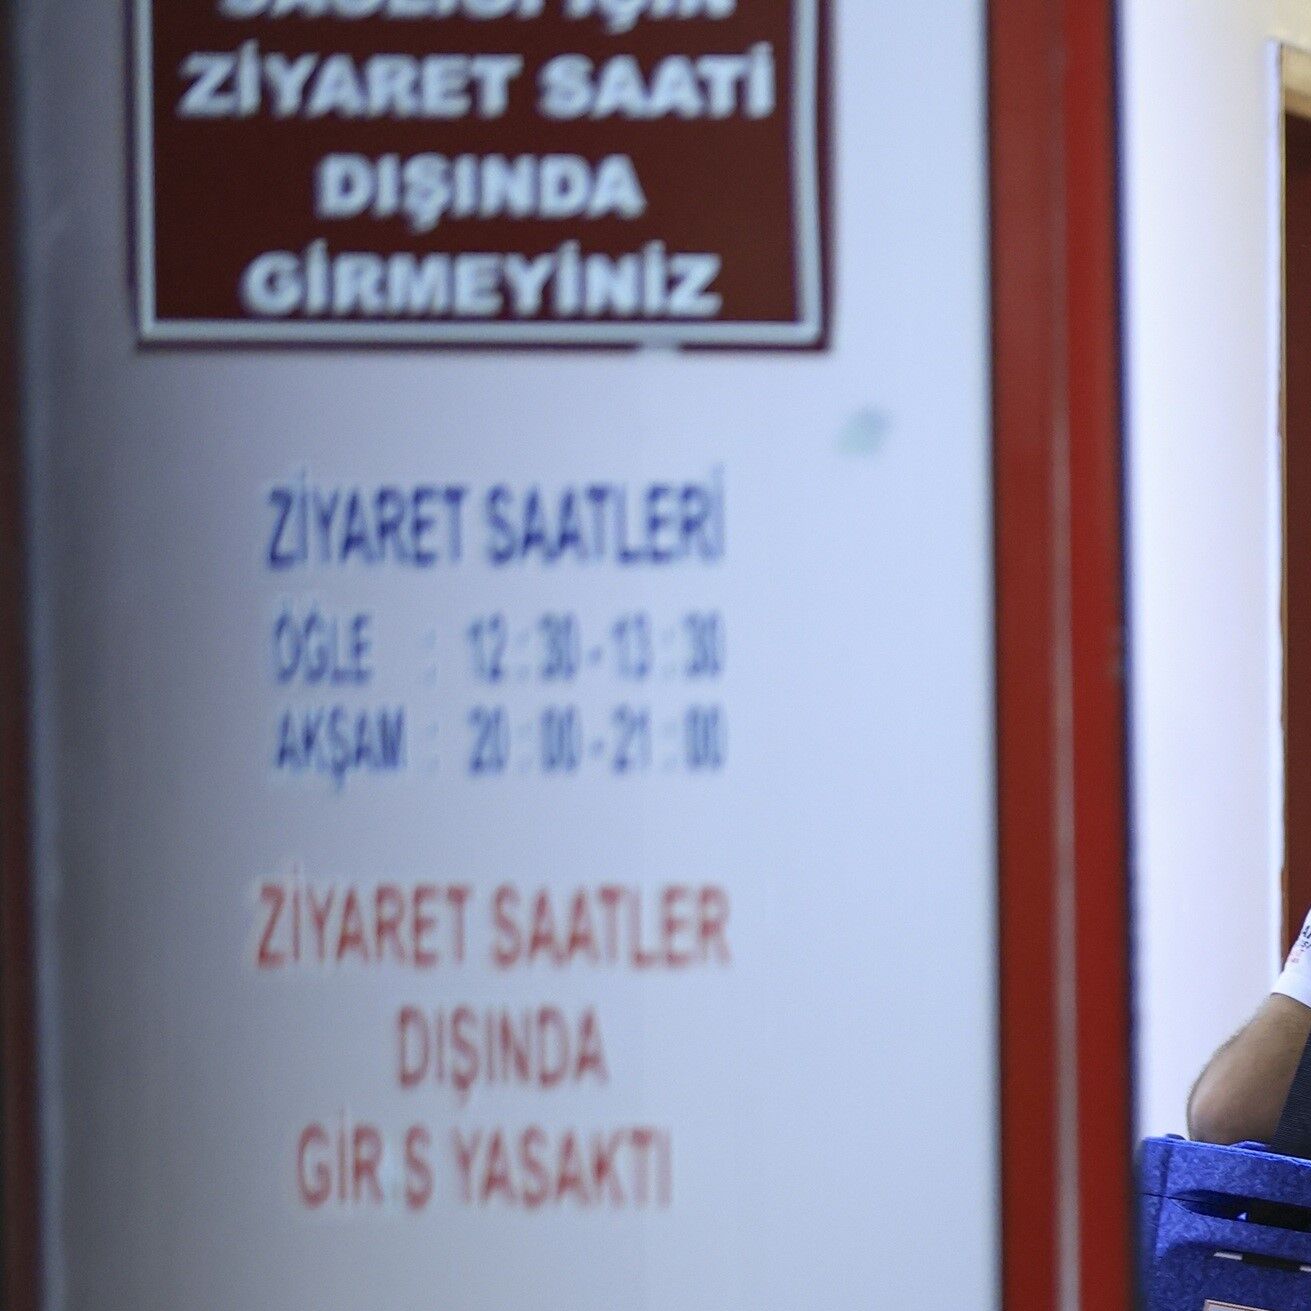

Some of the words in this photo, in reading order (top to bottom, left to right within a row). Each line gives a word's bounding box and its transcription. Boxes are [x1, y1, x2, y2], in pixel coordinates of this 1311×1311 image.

[177, 38, 522, 118] ZİYARET
[537, 42, 775, 118] SAATİ
[316, 152, 646, 233] DIŞINDA
[241, 239, 721, 316] GİRMEYİNİZ
[264, 467, 472, 571] ZİYARET
[484, 461, 727, 570] SAATLERİ
[274, 702, 407, 792] AKŞAM
[257, 866, 471, 969] ZİYARET
[490, 884, 732, 970] SAATLER
[395, 1004, 609, 1106] DIŞINDA
[450, 1124, 673, 1211] YASAKTI
